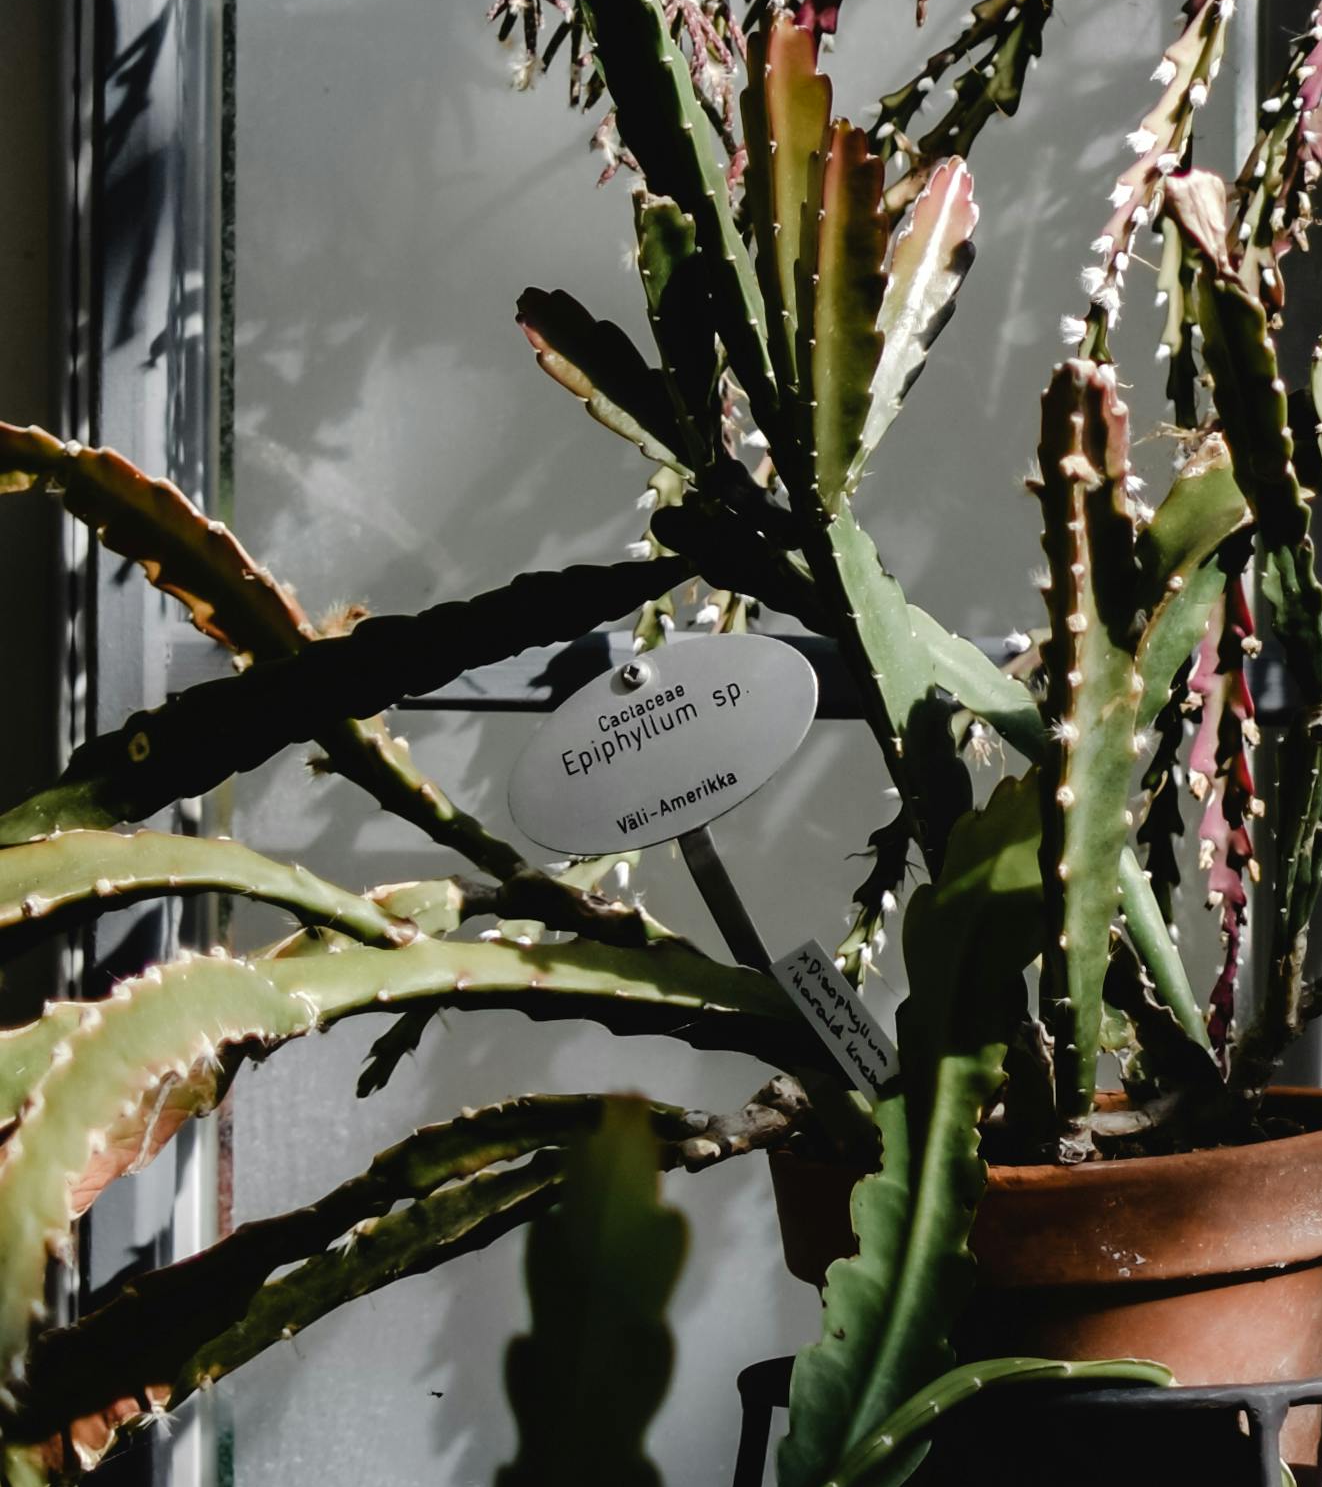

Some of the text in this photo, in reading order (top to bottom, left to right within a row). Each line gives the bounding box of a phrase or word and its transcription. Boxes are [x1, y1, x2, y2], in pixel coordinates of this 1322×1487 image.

[561, 682, 750, 776] Epiphyllum sp.
[598, 684, 686, 733] Cactaceae
[616, 770, 738, 835] Väli-Amerikka
